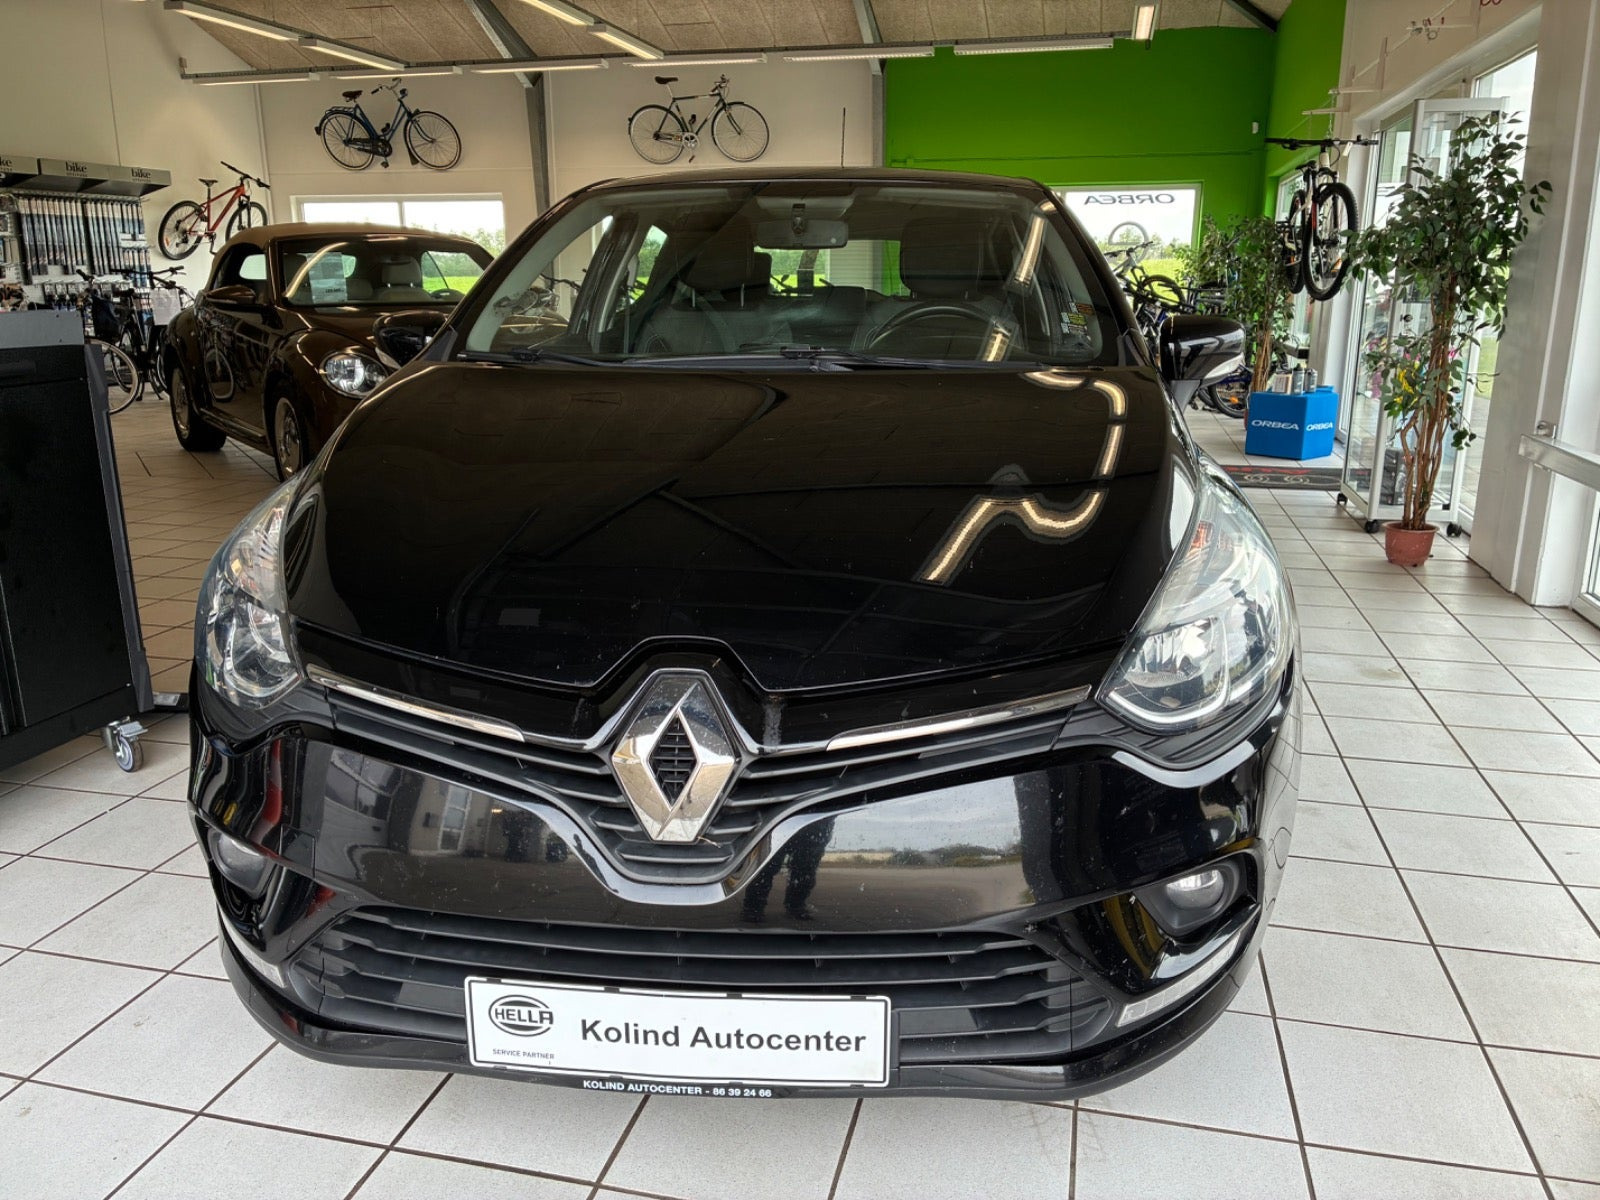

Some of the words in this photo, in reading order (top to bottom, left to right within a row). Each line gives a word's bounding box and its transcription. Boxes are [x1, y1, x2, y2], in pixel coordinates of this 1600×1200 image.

[65, 161, 87, 172] bike
[131, 168, 151, 178] bike
[1252, 420, 1299, 430] ORBEA
[1306, 422, 1334, 431] ORBEA
[494, 1007, 554, 1025] HELLA
[581, 1018, 681, 1048] Kolind
[689, 1025, 867, 1052] Autocenter
[492, 1048, 521, 1057] SERVICE
[522, 1051, 555, 1060] PARTNER
[583, 1080, 625, 1091] KOLIND
[627, 1083, 702, 1095] AUTOCENTER
[712, 1087, 726, 1096] 86
[727, 1088, 741, 1096] 39
[743, 1088, 756, 1097] 24
